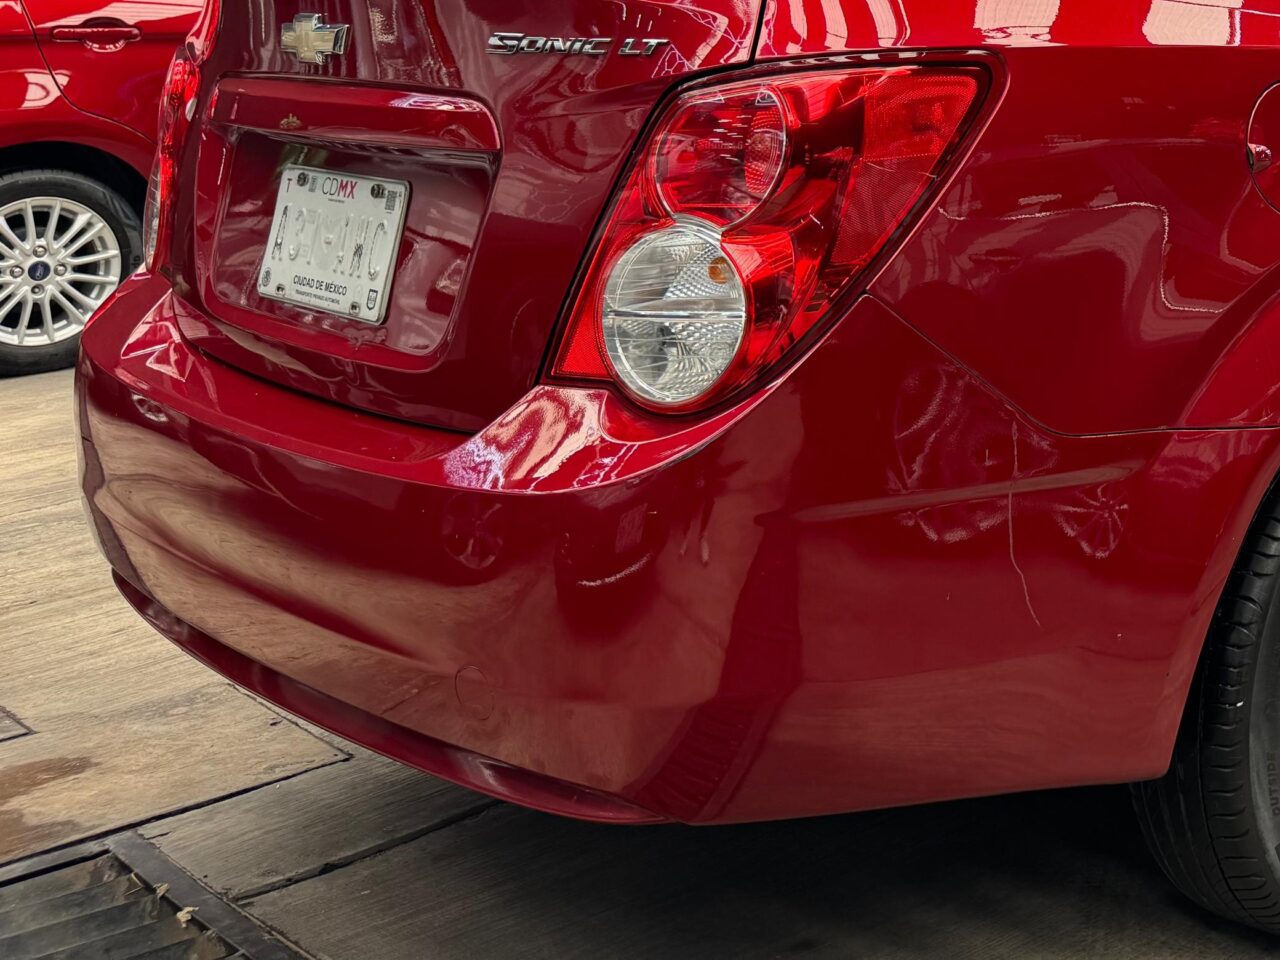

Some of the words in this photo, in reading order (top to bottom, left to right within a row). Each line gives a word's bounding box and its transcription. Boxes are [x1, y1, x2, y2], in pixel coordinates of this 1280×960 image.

[485, 32, 612, 55] SONIC
[618, 38, 669, 55] LT
[286, 178, 293, 193] T
[322, 176, 358, 200] CDMX
[293, 274, 315, 289] CIUDAD
[315, 279, 324, 291] DE
[325, 280, 348, 296] MÉXICO
